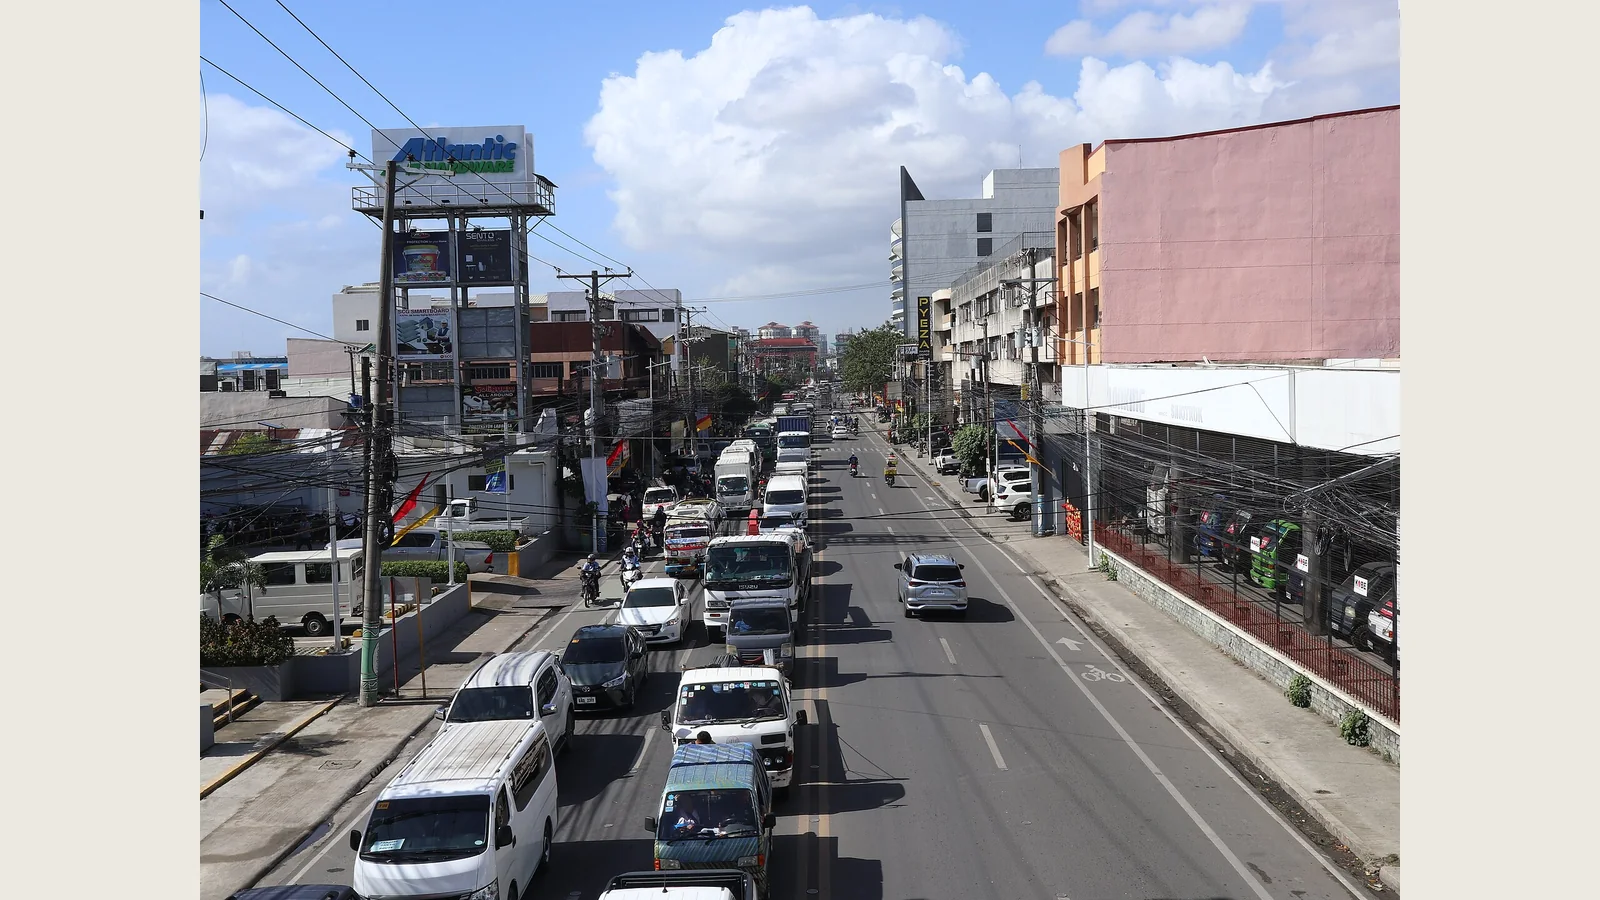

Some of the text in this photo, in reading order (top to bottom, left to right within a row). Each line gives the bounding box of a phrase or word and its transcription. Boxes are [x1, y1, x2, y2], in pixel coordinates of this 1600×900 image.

[392, 134, 516, 162] Atlantic
[424, 160, 515, 173] HARDWARE
[466, 232, 495, 240] SENTO
[919, 298, 929, 349] PYEZA
